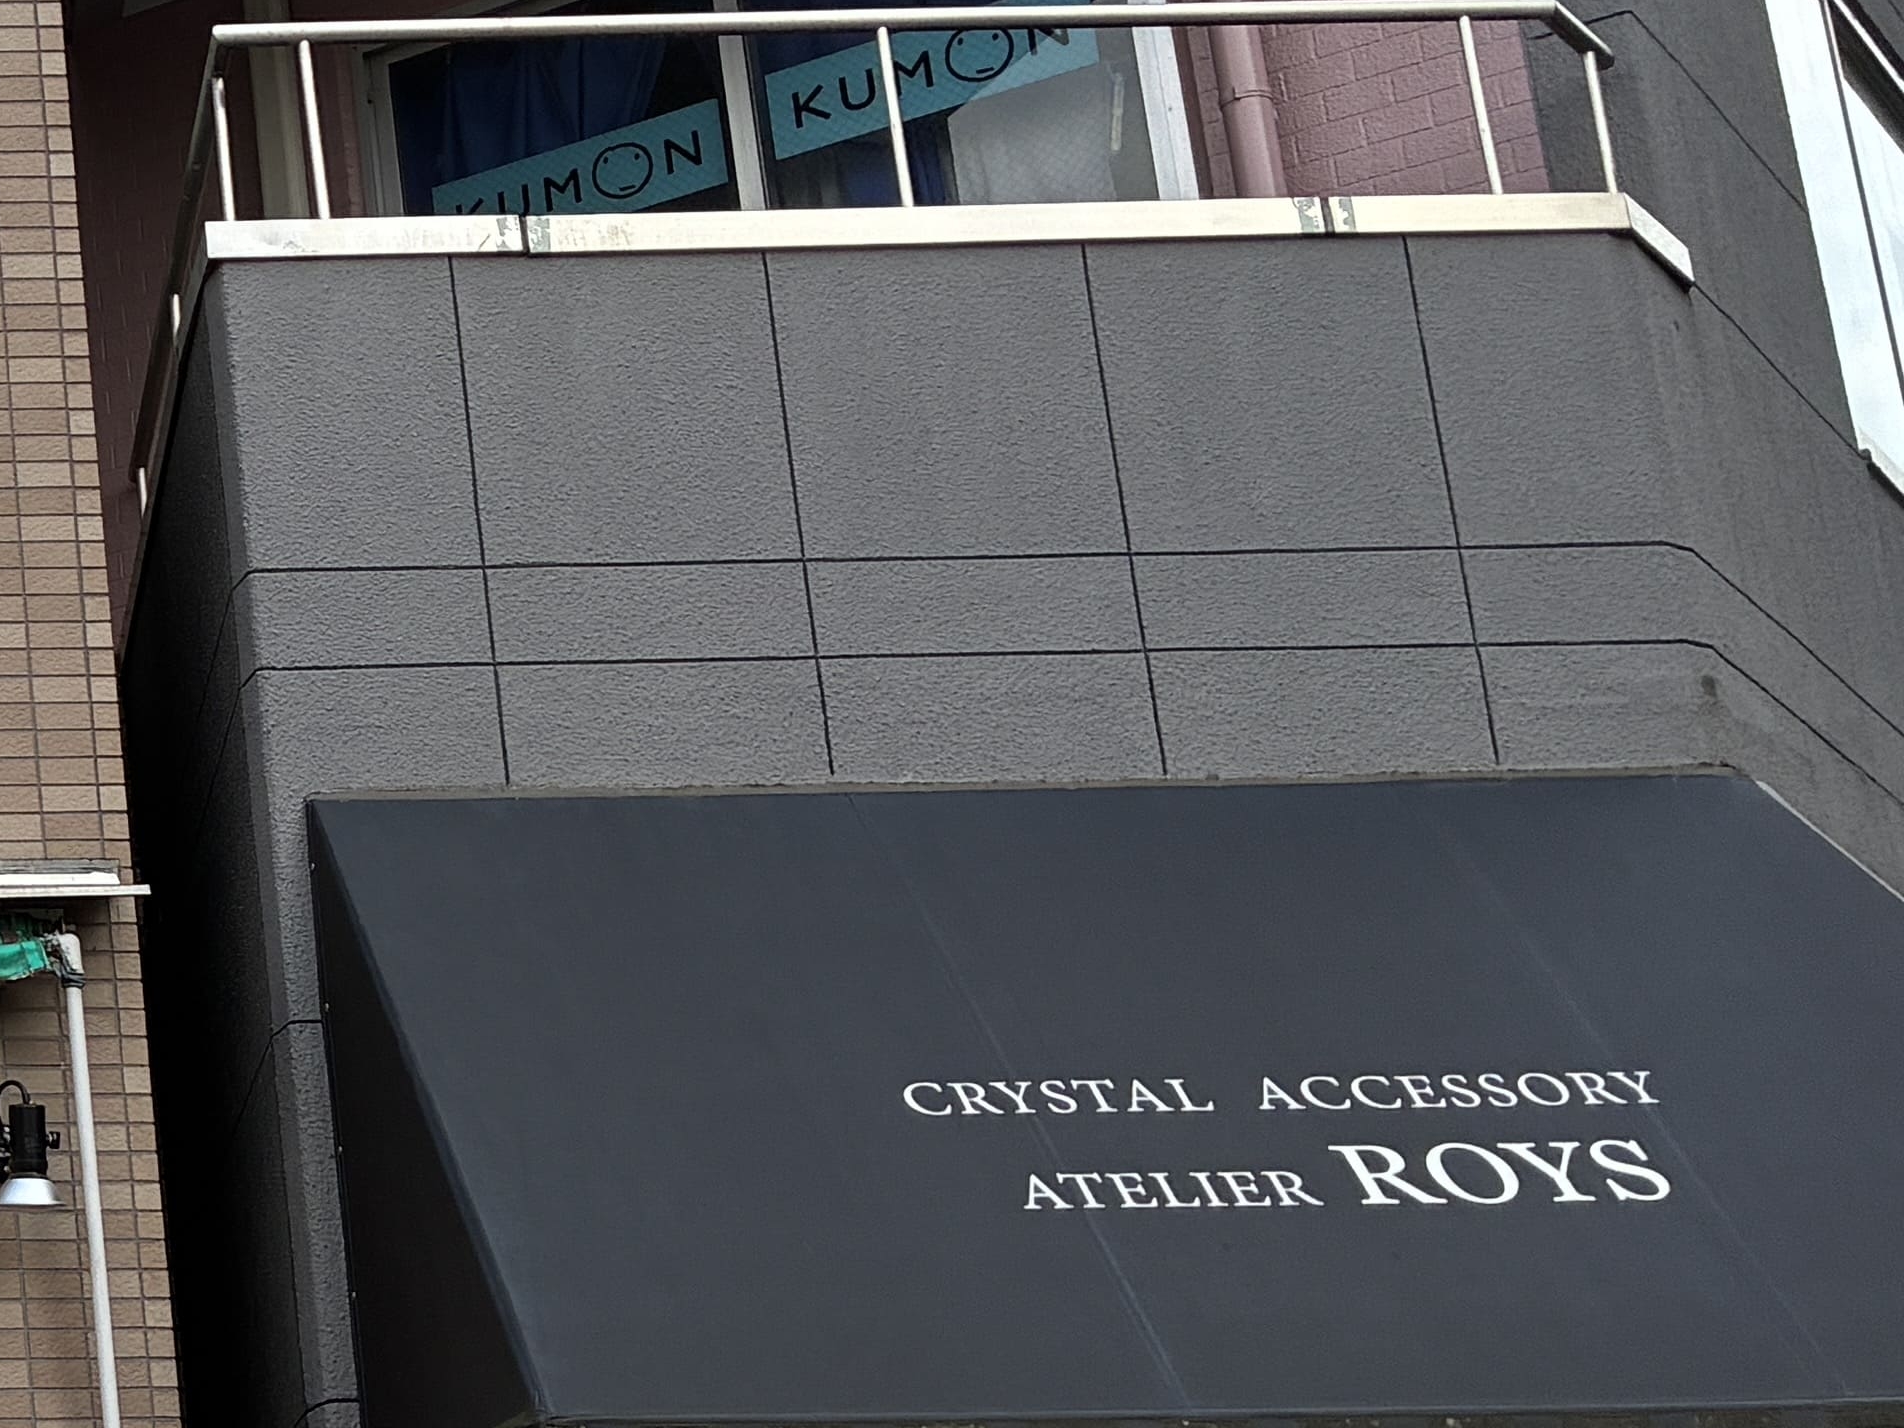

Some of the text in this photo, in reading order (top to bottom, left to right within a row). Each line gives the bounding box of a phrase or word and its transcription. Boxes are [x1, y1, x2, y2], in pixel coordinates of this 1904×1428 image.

[903, 1071, 1660, 1116] CRYSTAL ACCESSORY
[1023, 1139, 1671, 1210] ATELIER ROYS
